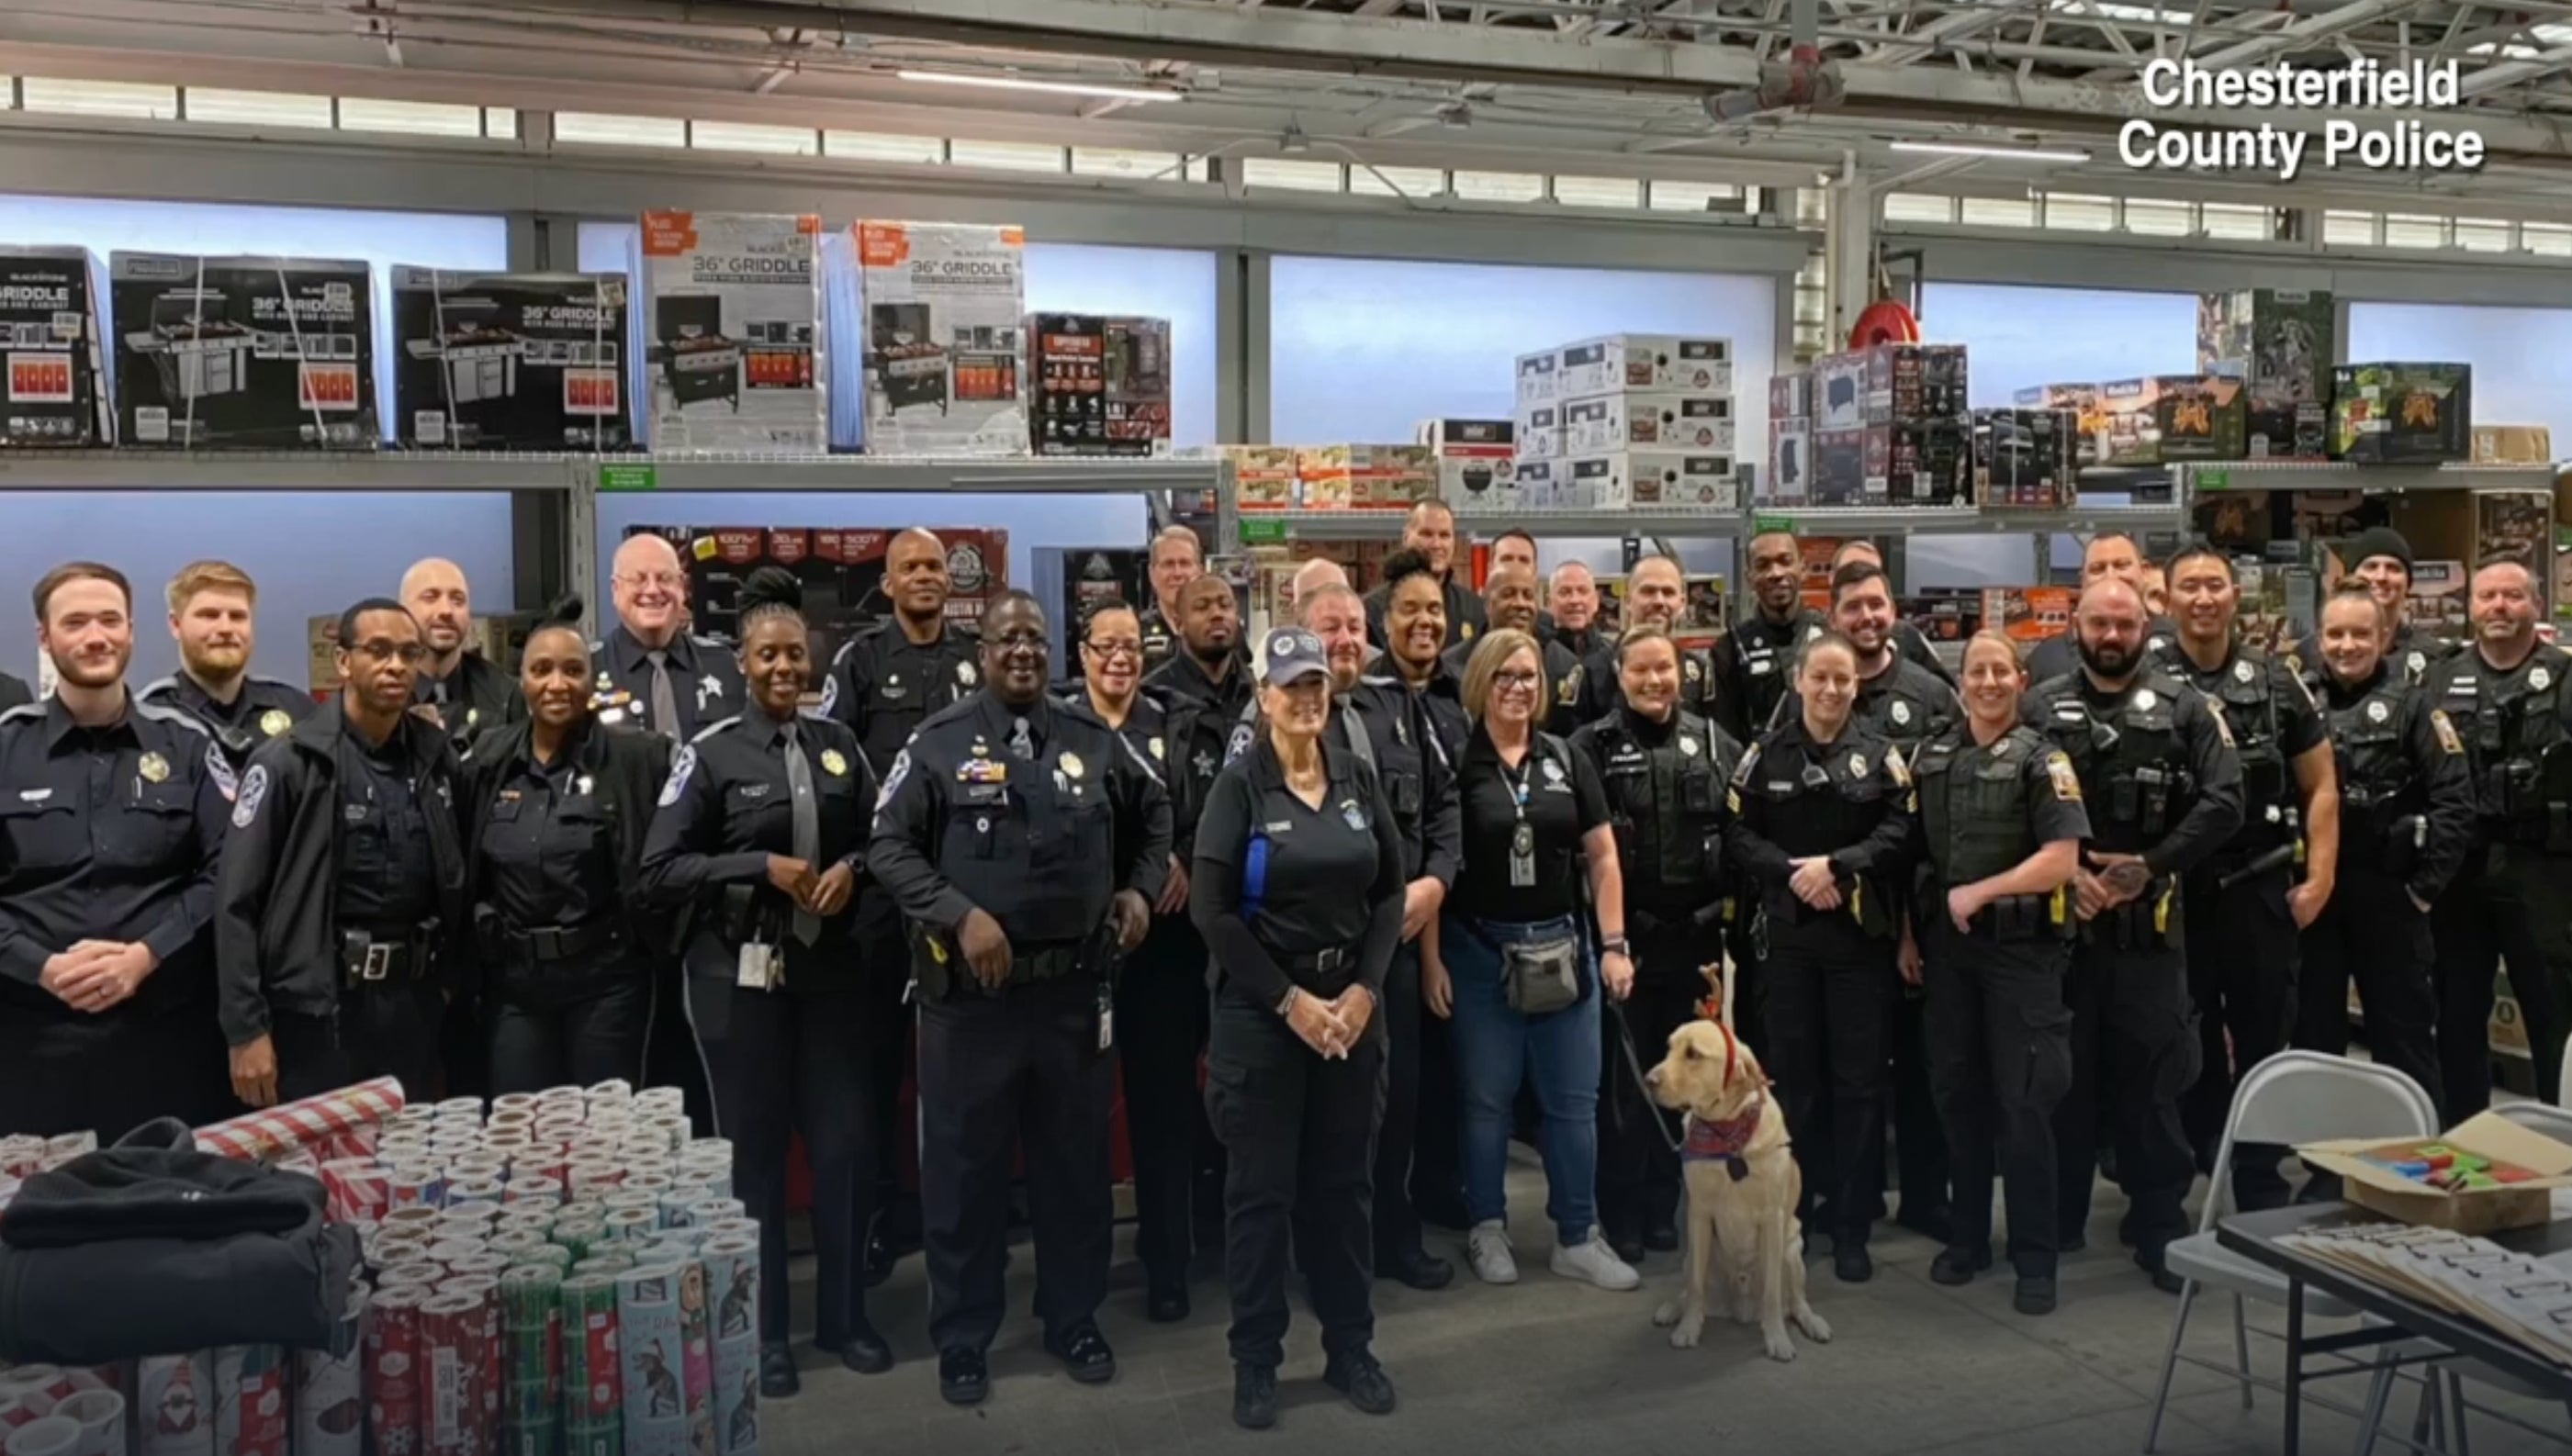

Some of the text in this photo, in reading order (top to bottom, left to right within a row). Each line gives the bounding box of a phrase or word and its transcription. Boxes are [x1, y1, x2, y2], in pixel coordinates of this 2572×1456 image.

[694, 256, 811, 274] 36" GRIDDLE
[943, 262, 1012, 275] GRIDDLE
[0, 286, 69, 300] RIDDLE
[549, 308, 616, 321] GRIDDLE
